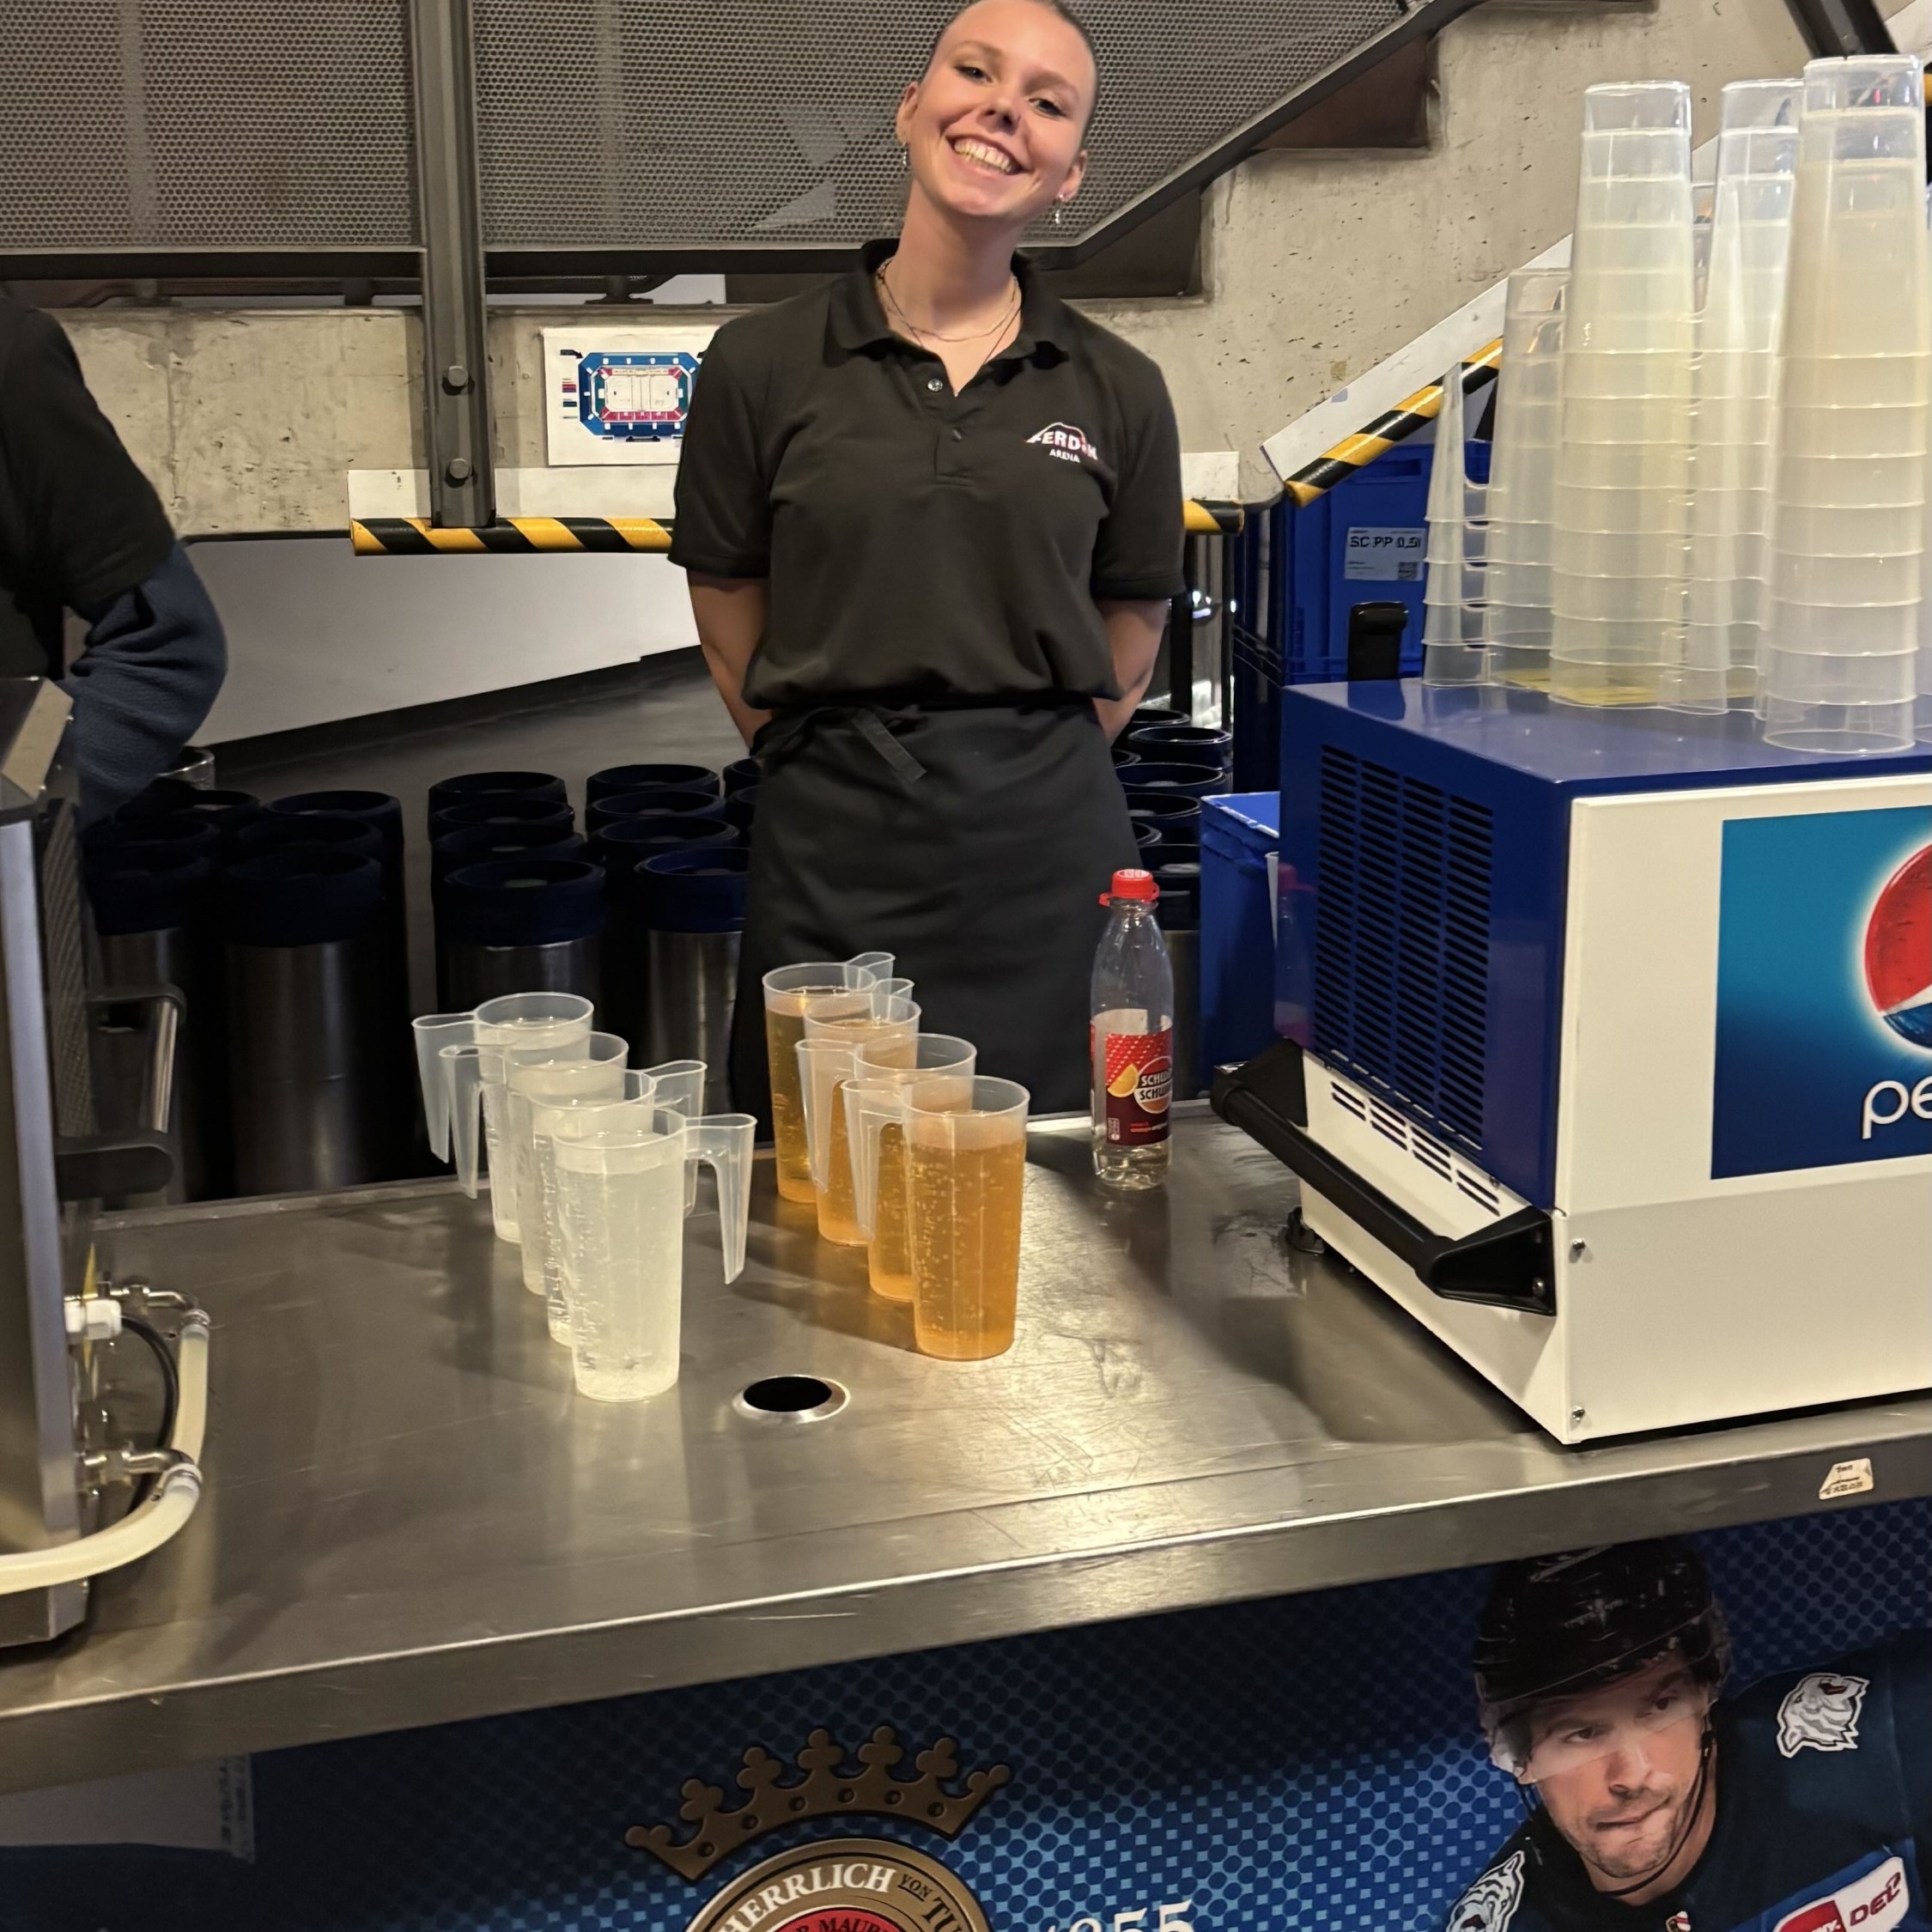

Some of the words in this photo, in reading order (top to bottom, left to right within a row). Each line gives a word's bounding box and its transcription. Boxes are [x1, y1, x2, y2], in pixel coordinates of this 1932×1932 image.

[1350, 537, 1370, 548] SC
[1373, 537, 1394, 548] PP
[718, 1863, 897, 1932] HERRLICH
[899, 1874, 933, 1899] VON
